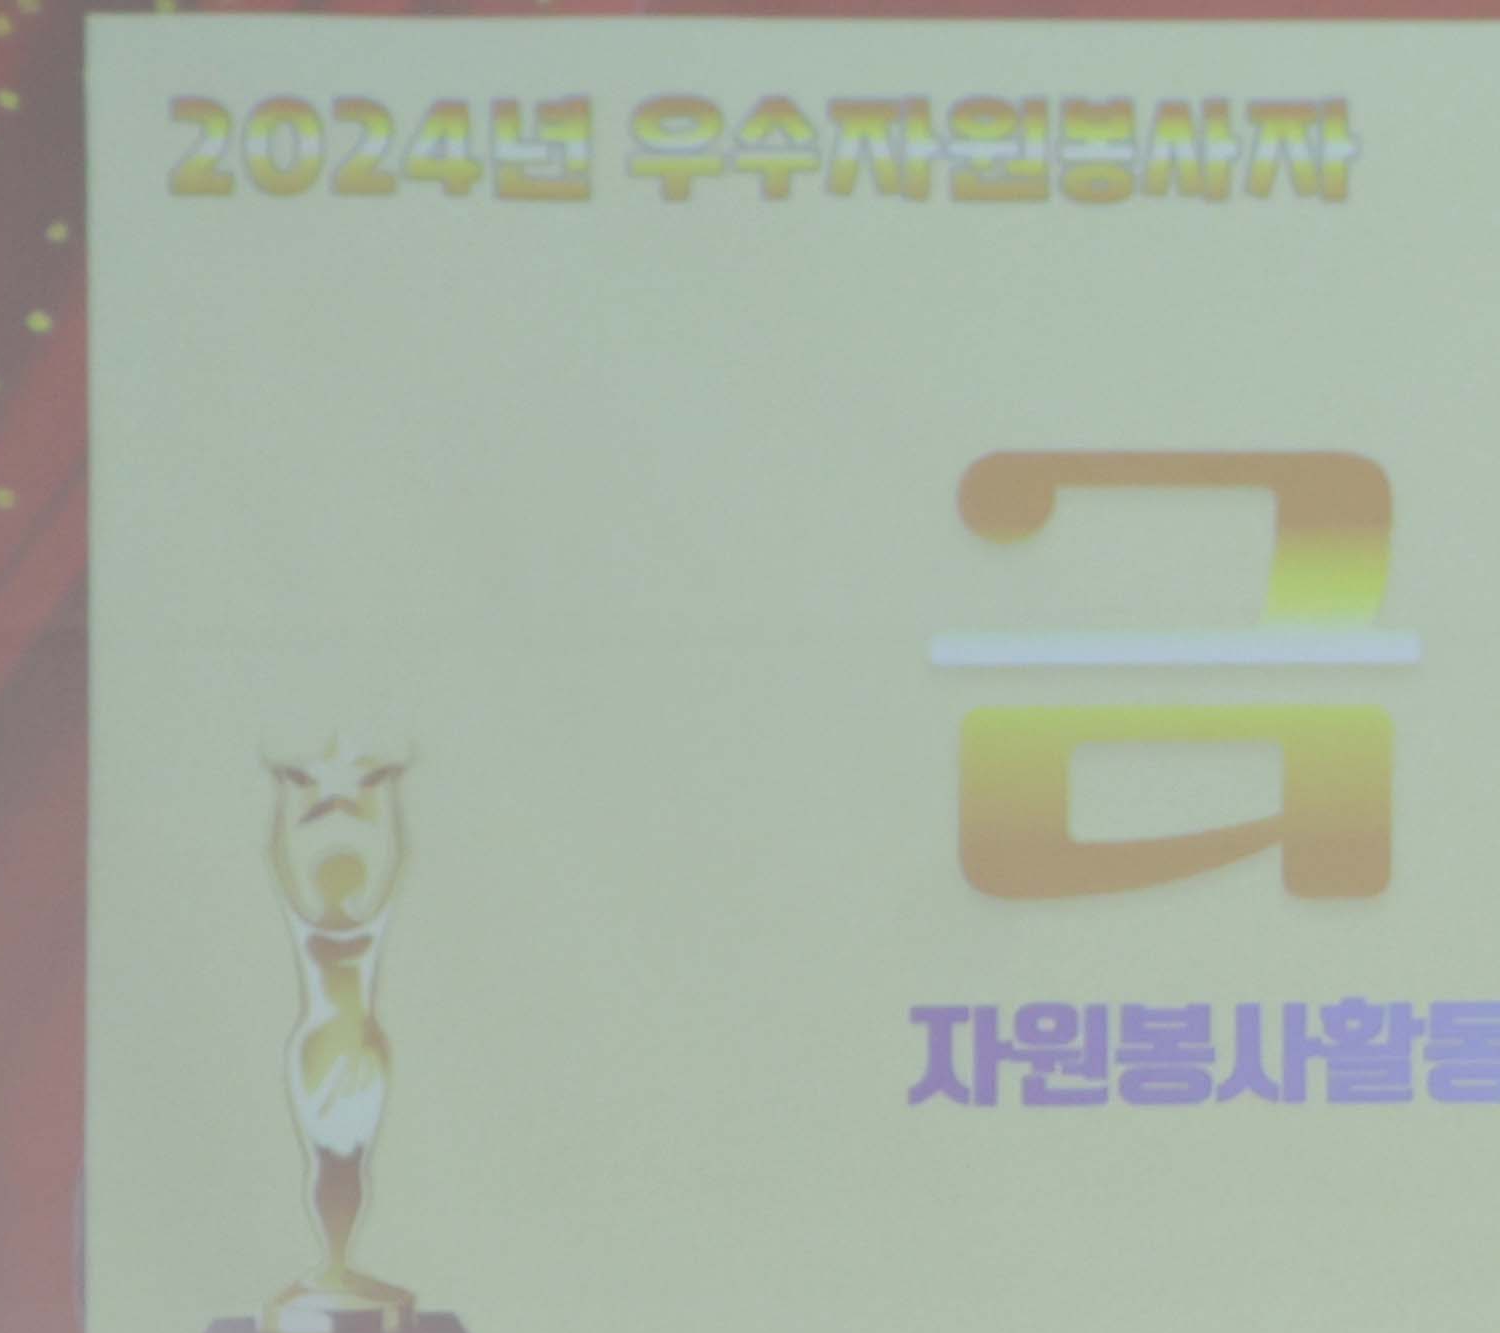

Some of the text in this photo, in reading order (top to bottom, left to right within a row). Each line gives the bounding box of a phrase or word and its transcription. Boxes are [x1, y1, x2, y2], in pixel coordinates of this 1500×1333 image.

[166, 92, 1362, 205] 2024년 우수자원봉사자
[929, 448, 1422, 902] 금
